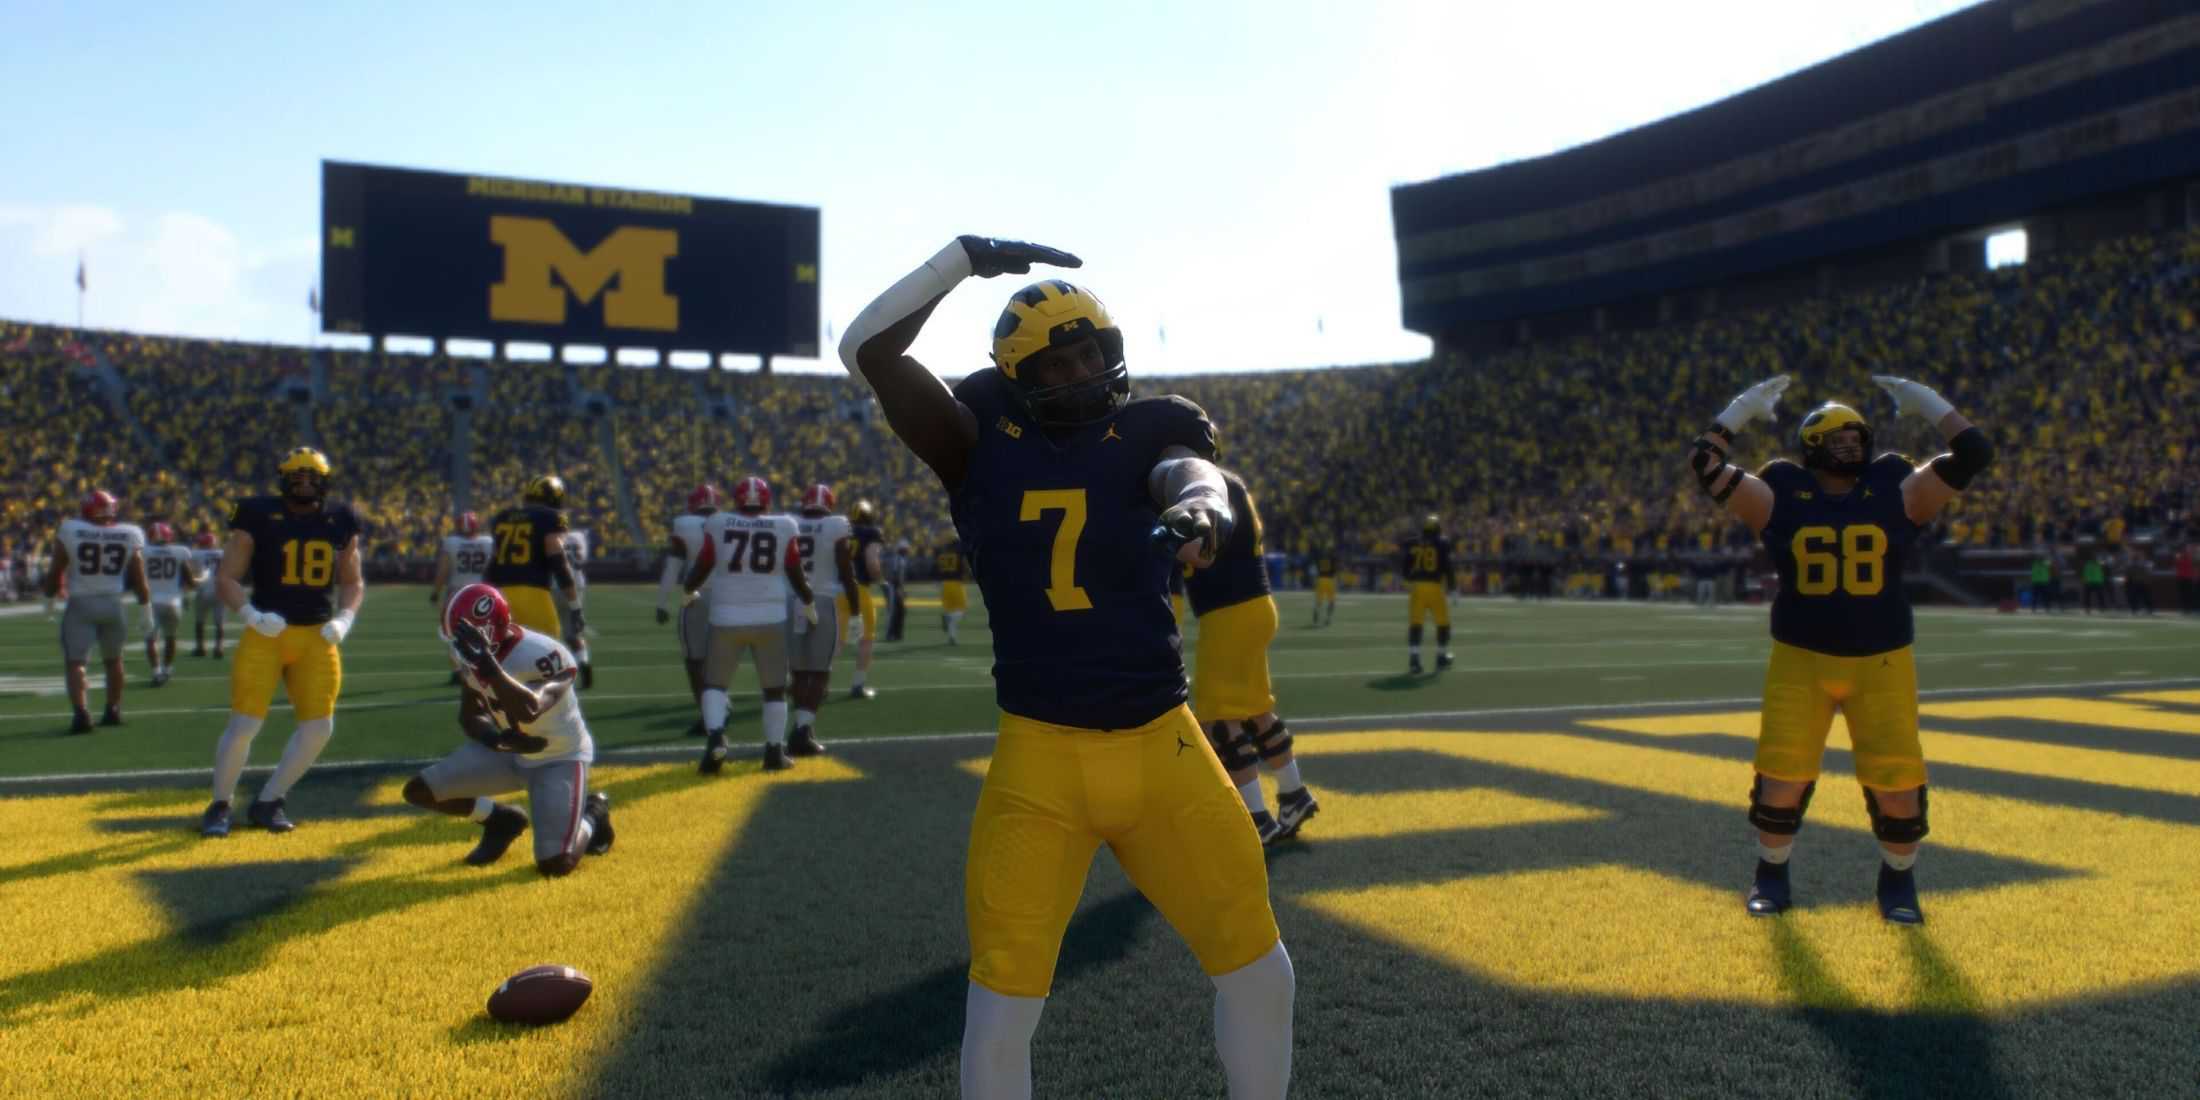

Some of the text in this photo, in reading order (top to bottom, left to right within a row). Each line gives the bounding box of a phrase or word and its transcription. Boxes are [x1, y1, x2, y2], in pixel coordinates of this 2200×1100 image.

[468, 177, 693, 214] MICHIGAN STADIUM
[330, 227, 353, 248] M
[489, 214, 679, 331] M
[796, 264, 816, 283] M
[77, 542, 127, 576] 93
[457, 550, 488, 574] 32
[494, 523, 533, 566] 75
[723, 530, 777, 574] 78
[1019, 488, 1093, 610] 7
[1410, 547, 1437, 571] 78
[1792, 524, 1889, 597] 68
[147, 557, 177, 580] 20
[280, 539, 334, 586] 18
[535, 650, 564, 679] 97
